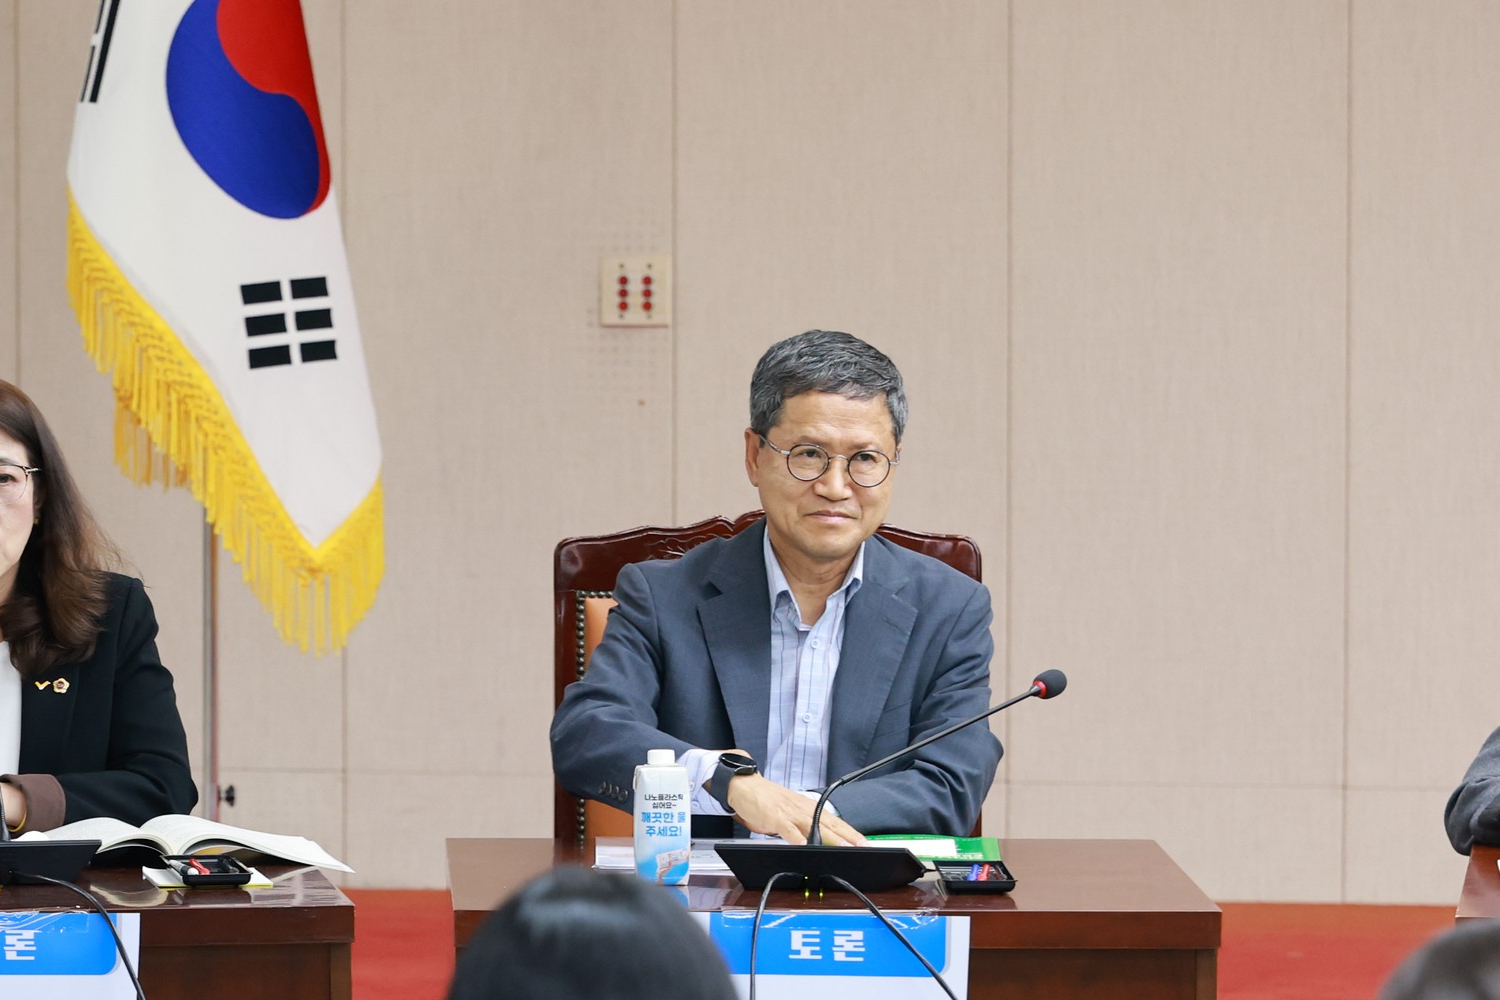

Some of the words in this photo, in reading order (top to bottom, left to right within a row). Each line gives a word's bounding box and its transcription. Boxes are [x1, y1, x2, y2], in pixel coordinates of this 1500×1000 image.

[644, 793, 684, 801] 나노플라스틱
[641, 811, 674, 823] 깨끗한
[645, 825, 682, 837] 주세요!
[788, 929, 866, 962] 토론
